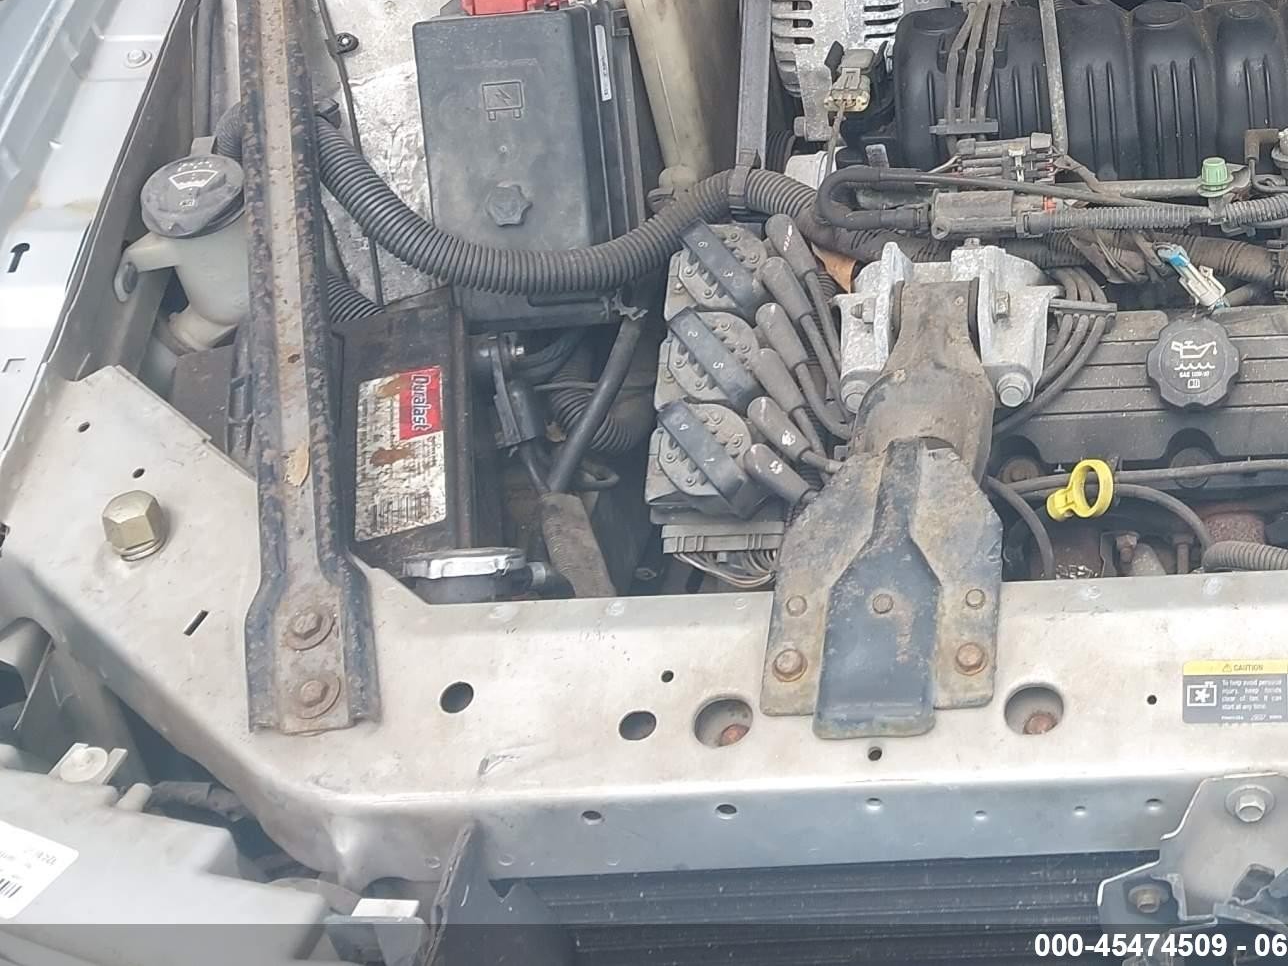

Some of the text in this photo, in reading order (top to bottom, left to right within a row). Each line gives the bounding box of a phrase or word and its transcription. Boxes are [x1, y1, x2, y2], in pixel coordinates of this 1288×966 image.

[723, 270, 734, 278] 3
[687, 330, 698, 338] 2
[713, 361, 724, 369] 5
[410, 374, 433, 432] Duralast
